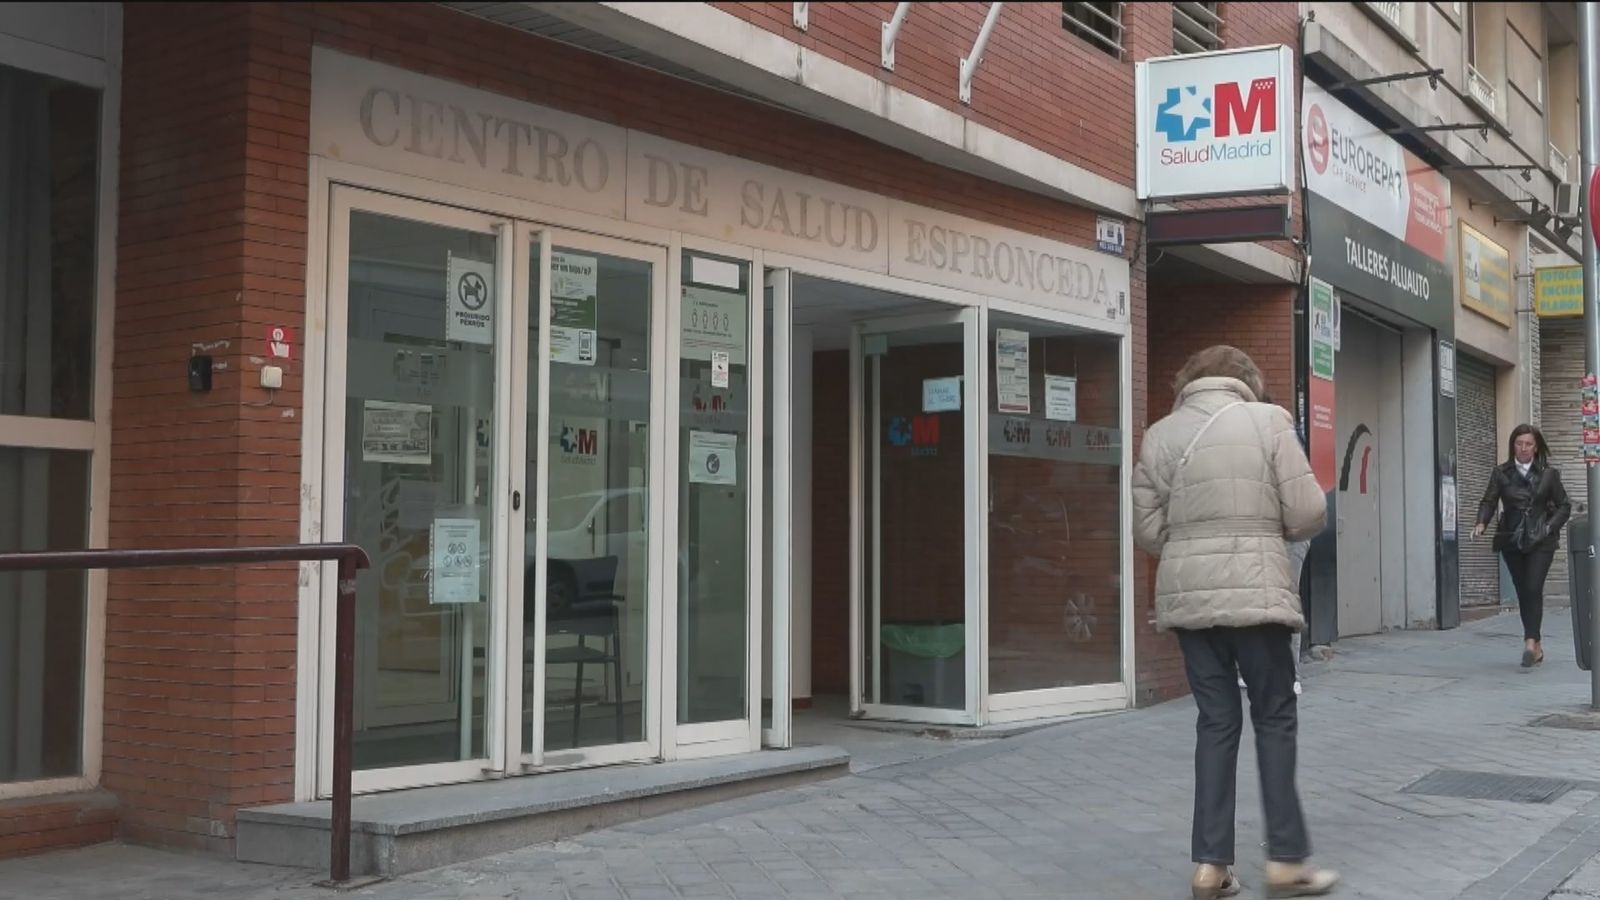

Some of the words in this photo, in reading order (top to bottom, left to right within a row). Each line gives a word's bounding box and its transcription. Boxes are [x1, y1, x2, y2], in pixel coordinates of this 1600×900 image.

[1214, 77, 1276, 138] M
[1160, 138, 1272, 166] SaludMadrid
[359, 86, 610, 194] CENTRO
[642, 152, 709, 218] DE
[740, 179, 879, 254] SALUD
[903, 218, 1113, 305] ESPRONCEDA
[1345, 174, 1367, 193] SERVICE
[1344, 236, 1389, 281] TALLERES
[1390, 260, 1430, 301] ALUAUTO
[455, 311, 490, 321] PROHIBIDO
[460, 318, 485, 328] PERROS
